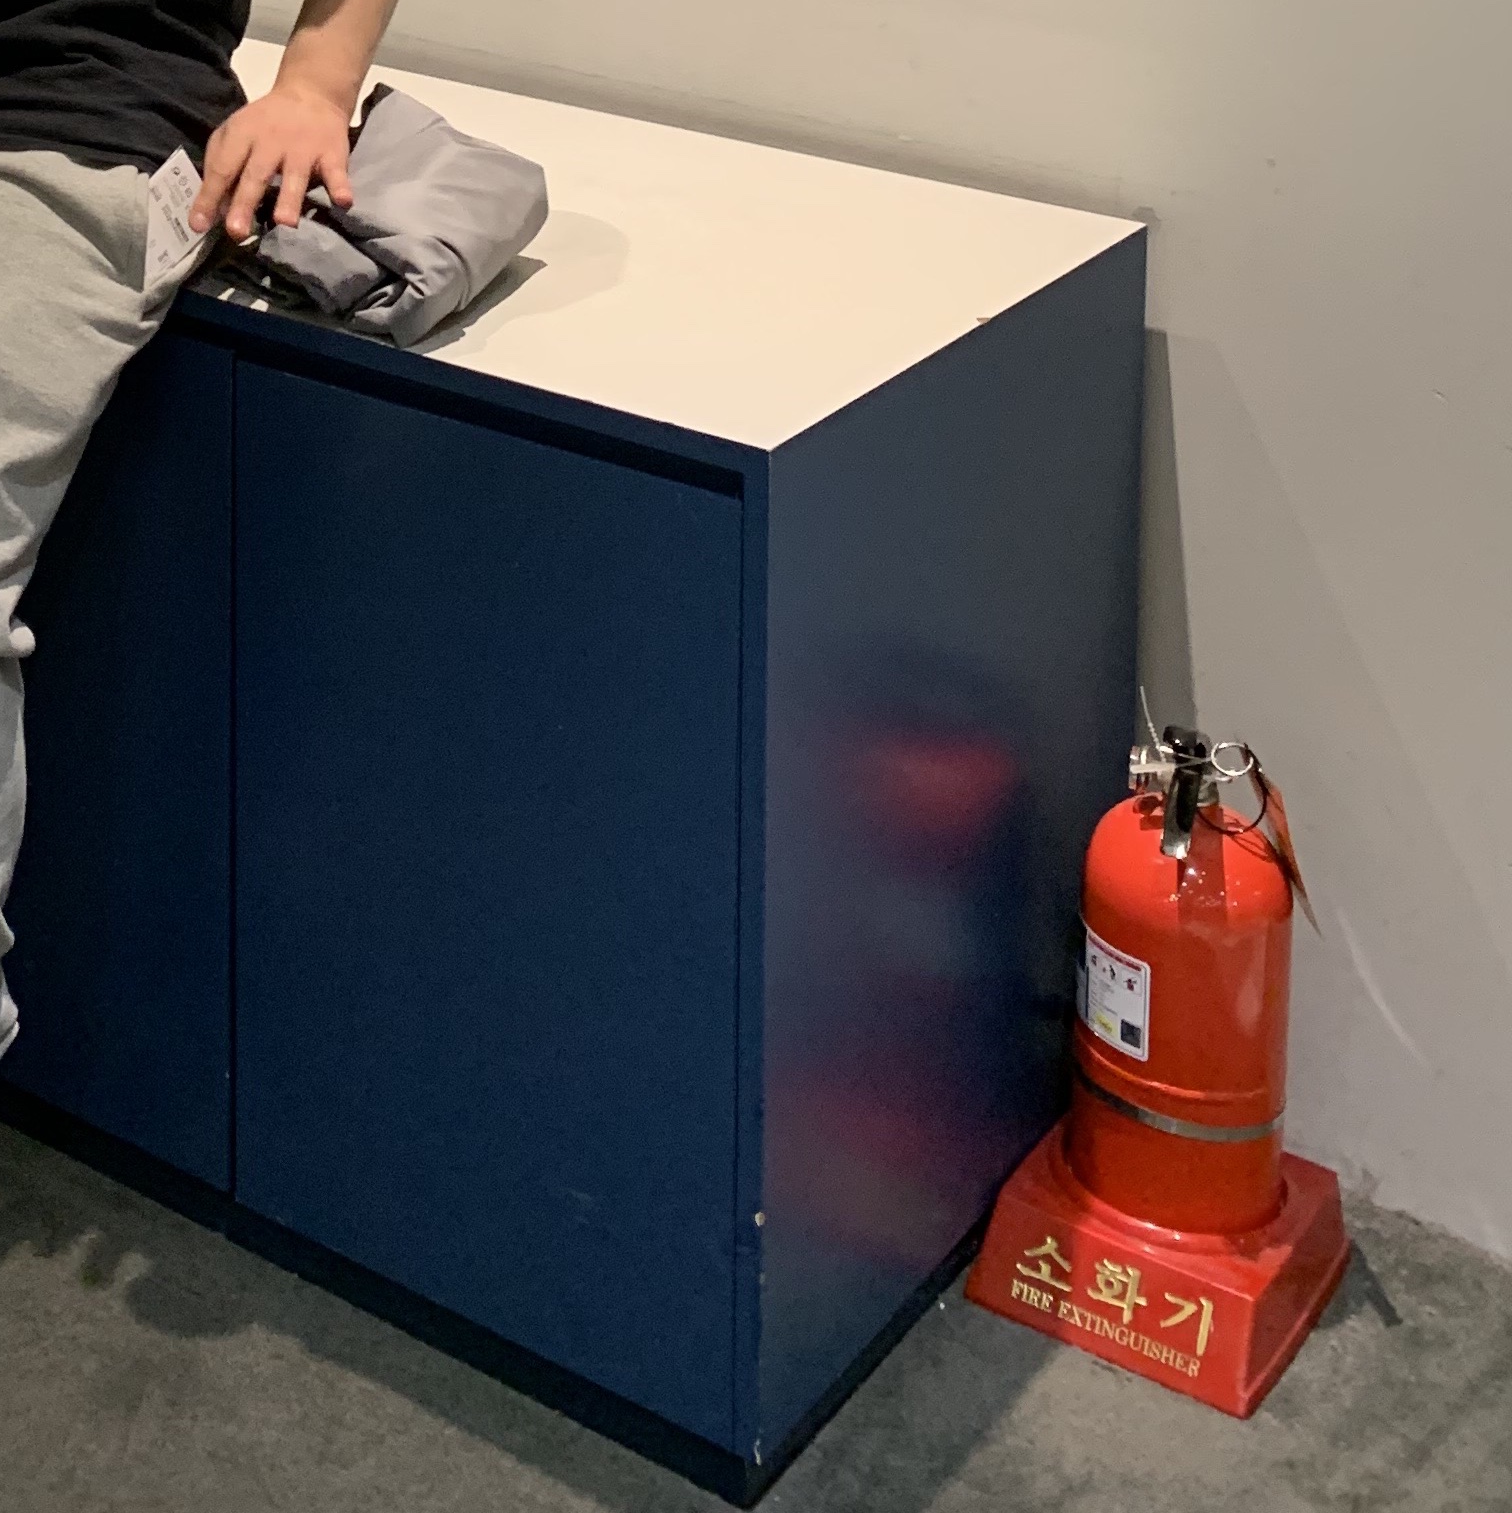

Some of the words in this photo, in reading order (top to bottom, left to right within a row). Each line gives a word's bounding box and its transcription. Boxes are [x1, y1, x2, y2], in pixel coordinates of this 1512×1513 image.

[1010, 1278, 1054, 1314] FIRE
[1057, 1300, 1201, 1378] EXTINGUISHER
[1016, 1236, 1214, 1357] 소화기
